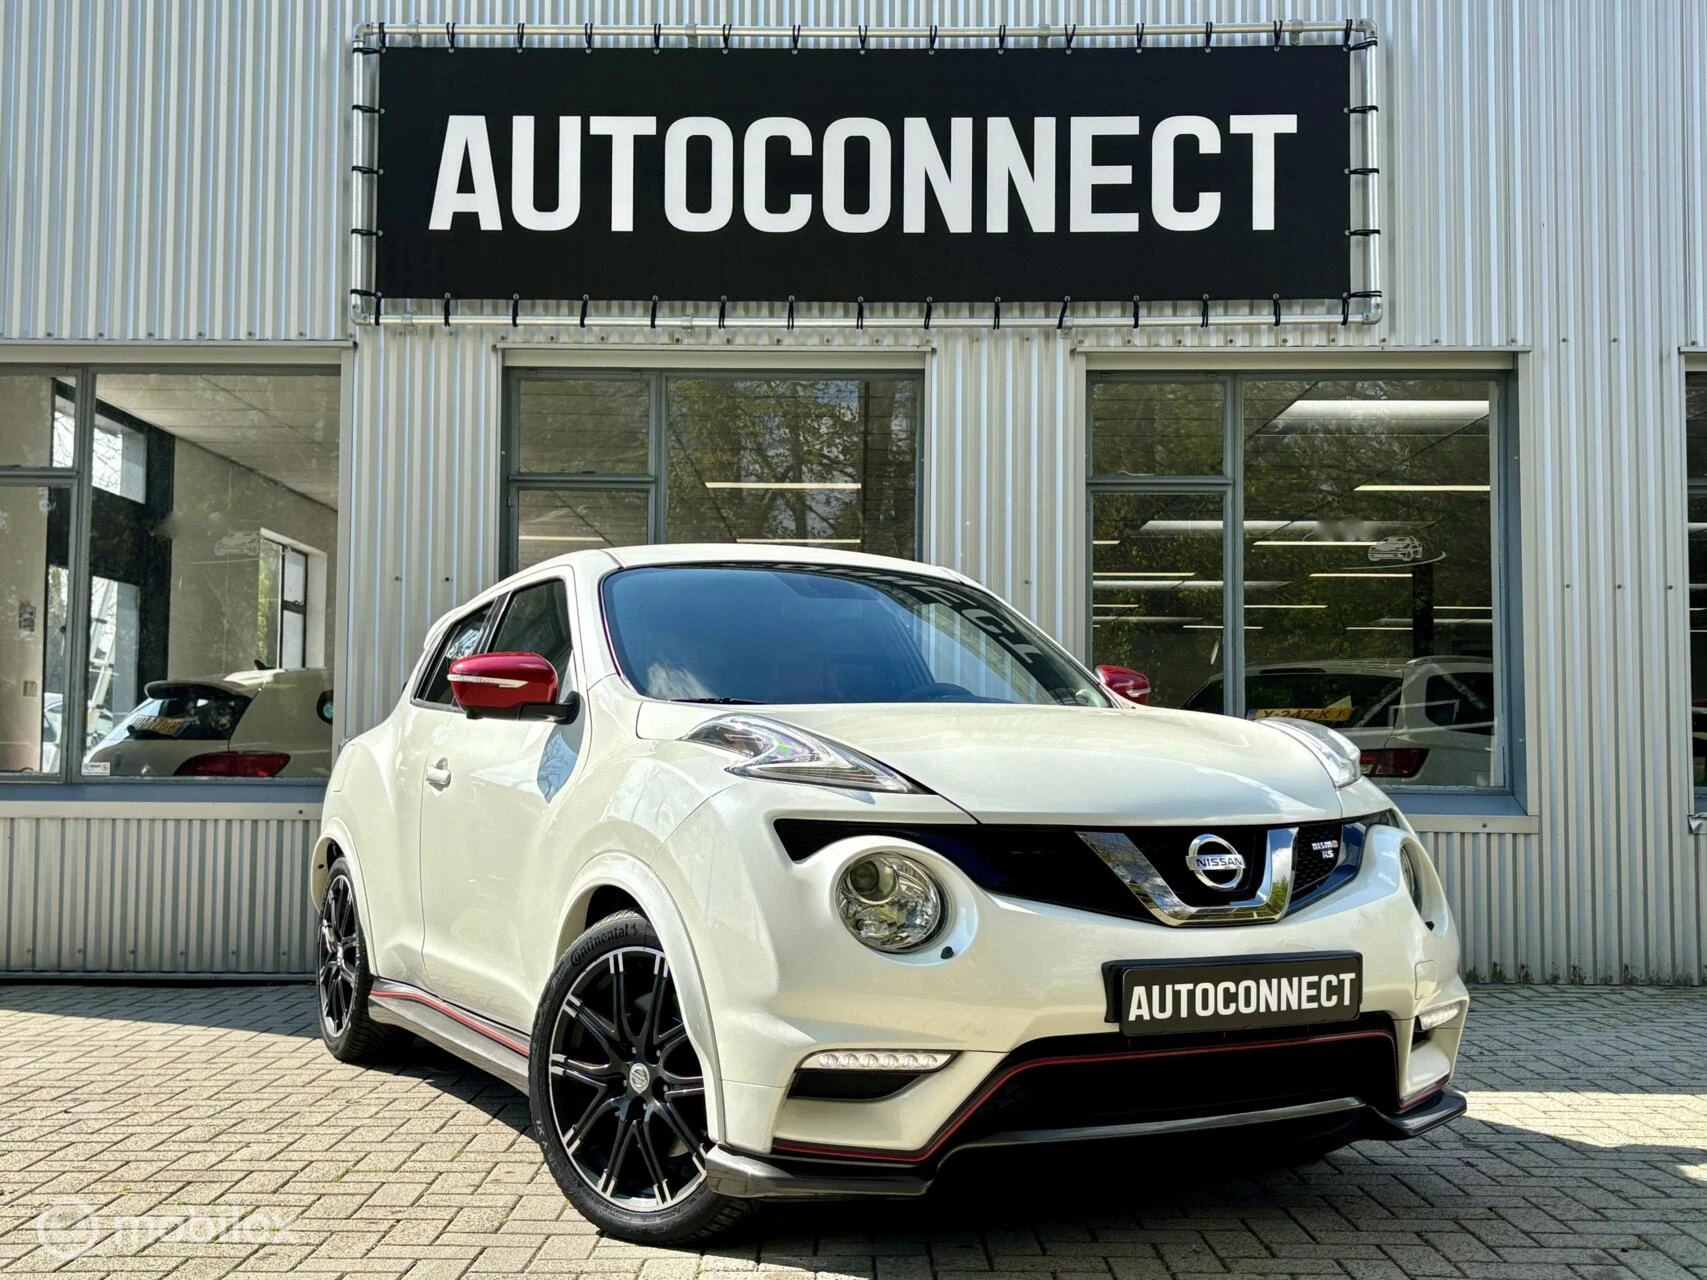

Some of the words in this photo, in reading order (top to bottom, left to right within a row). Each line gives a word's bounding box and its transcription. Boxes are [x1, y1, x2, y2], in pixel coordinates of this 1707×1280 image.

[429, 115, 1297, 233] AUTOCONNECT
[1195, 857, 1243, 867] NISSAN
[570, 923, 629, 966] Continental
[1129, 973, 1355, 1020] AUTOCONNECT
